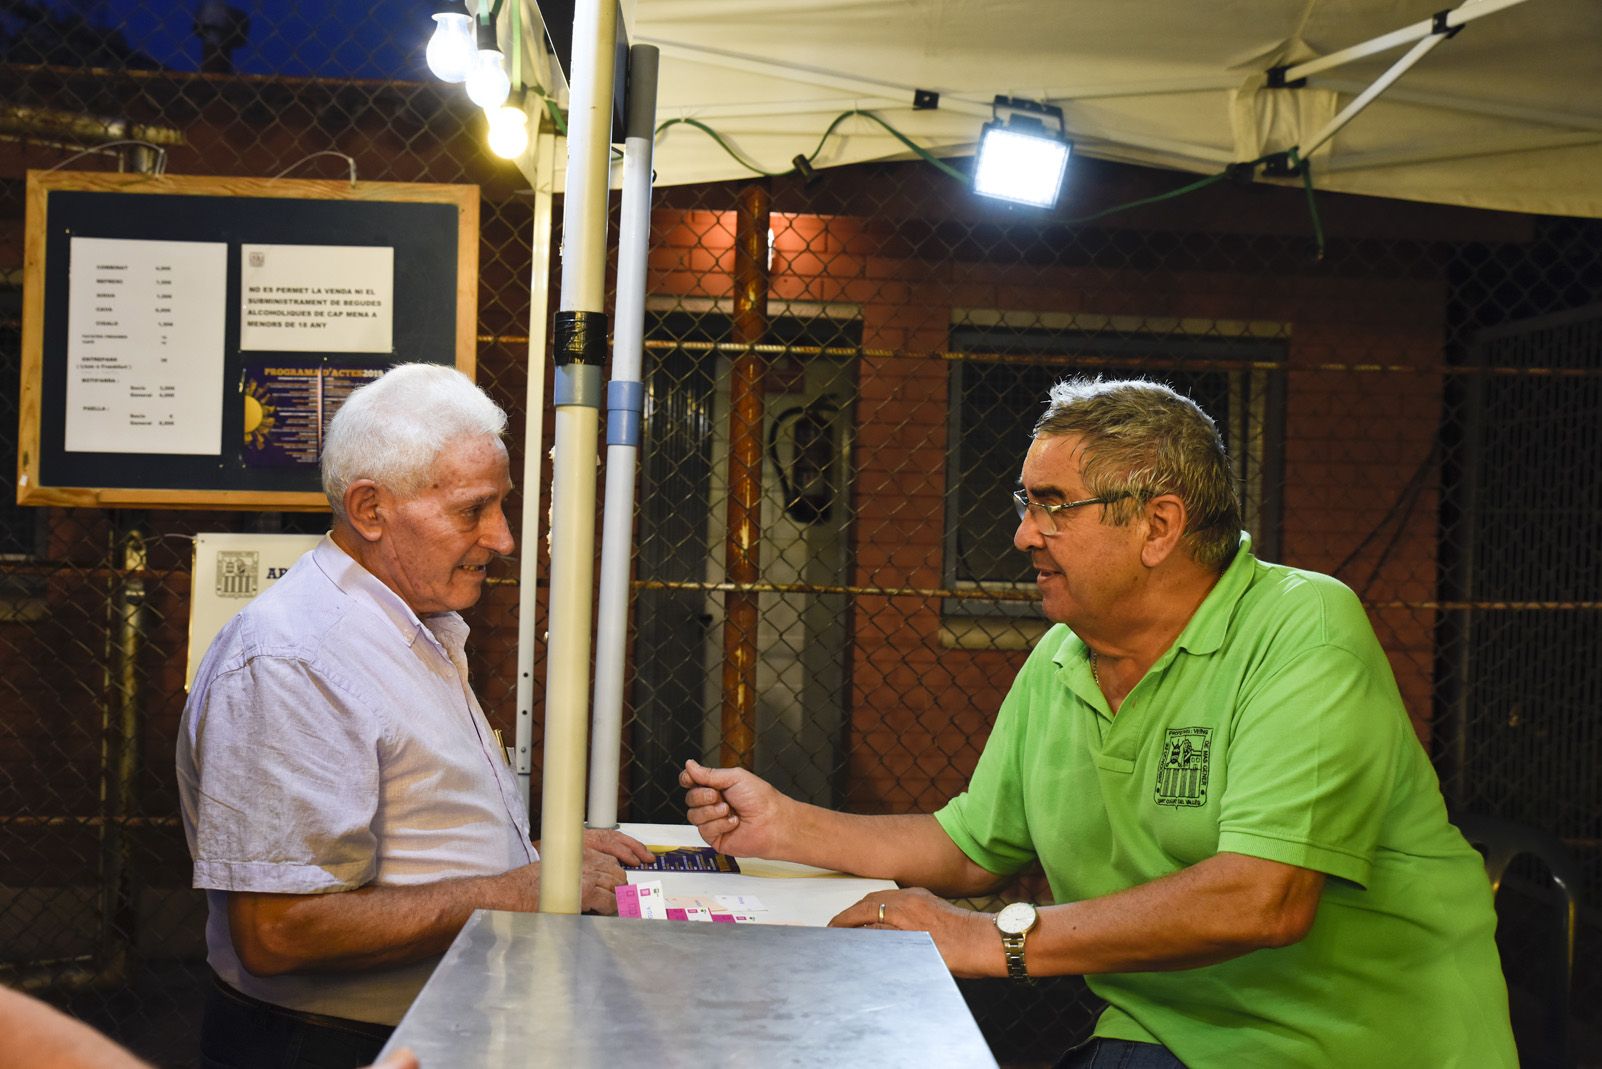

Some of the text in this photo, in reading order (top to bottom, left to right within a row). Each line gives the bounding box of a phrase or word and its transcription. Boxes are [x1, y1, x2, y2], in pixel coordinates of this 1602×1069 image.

[311, 287, 322, 295] LA
[248, 298, 328, 306] SUBMINISTRAMENT
[247, 310, 312, 318] ALCOHOLIQUES
